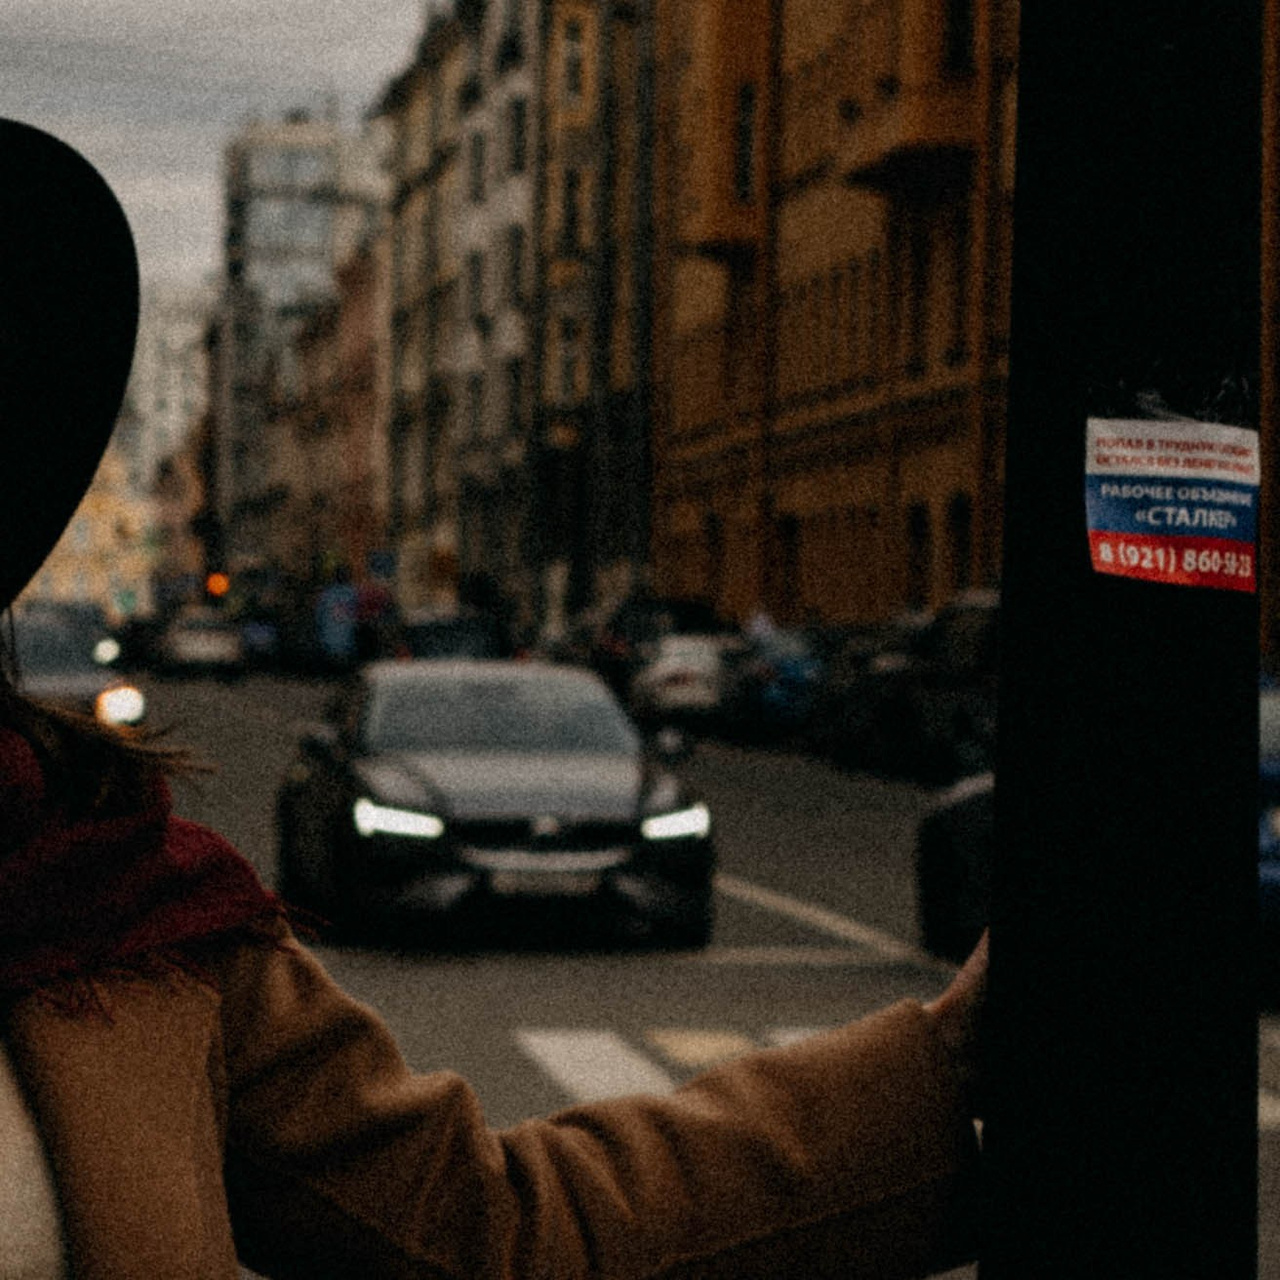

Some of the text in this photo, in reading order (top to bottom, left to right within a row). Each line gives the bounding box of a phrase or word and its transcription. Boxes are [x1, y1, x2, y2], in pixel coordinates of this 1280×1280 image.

[1101, 483, 1174, 501] РАБОЧЕЕ
[1099, 541, 1114, 564] 8
[1118, 540, 1176, 574] (921)
